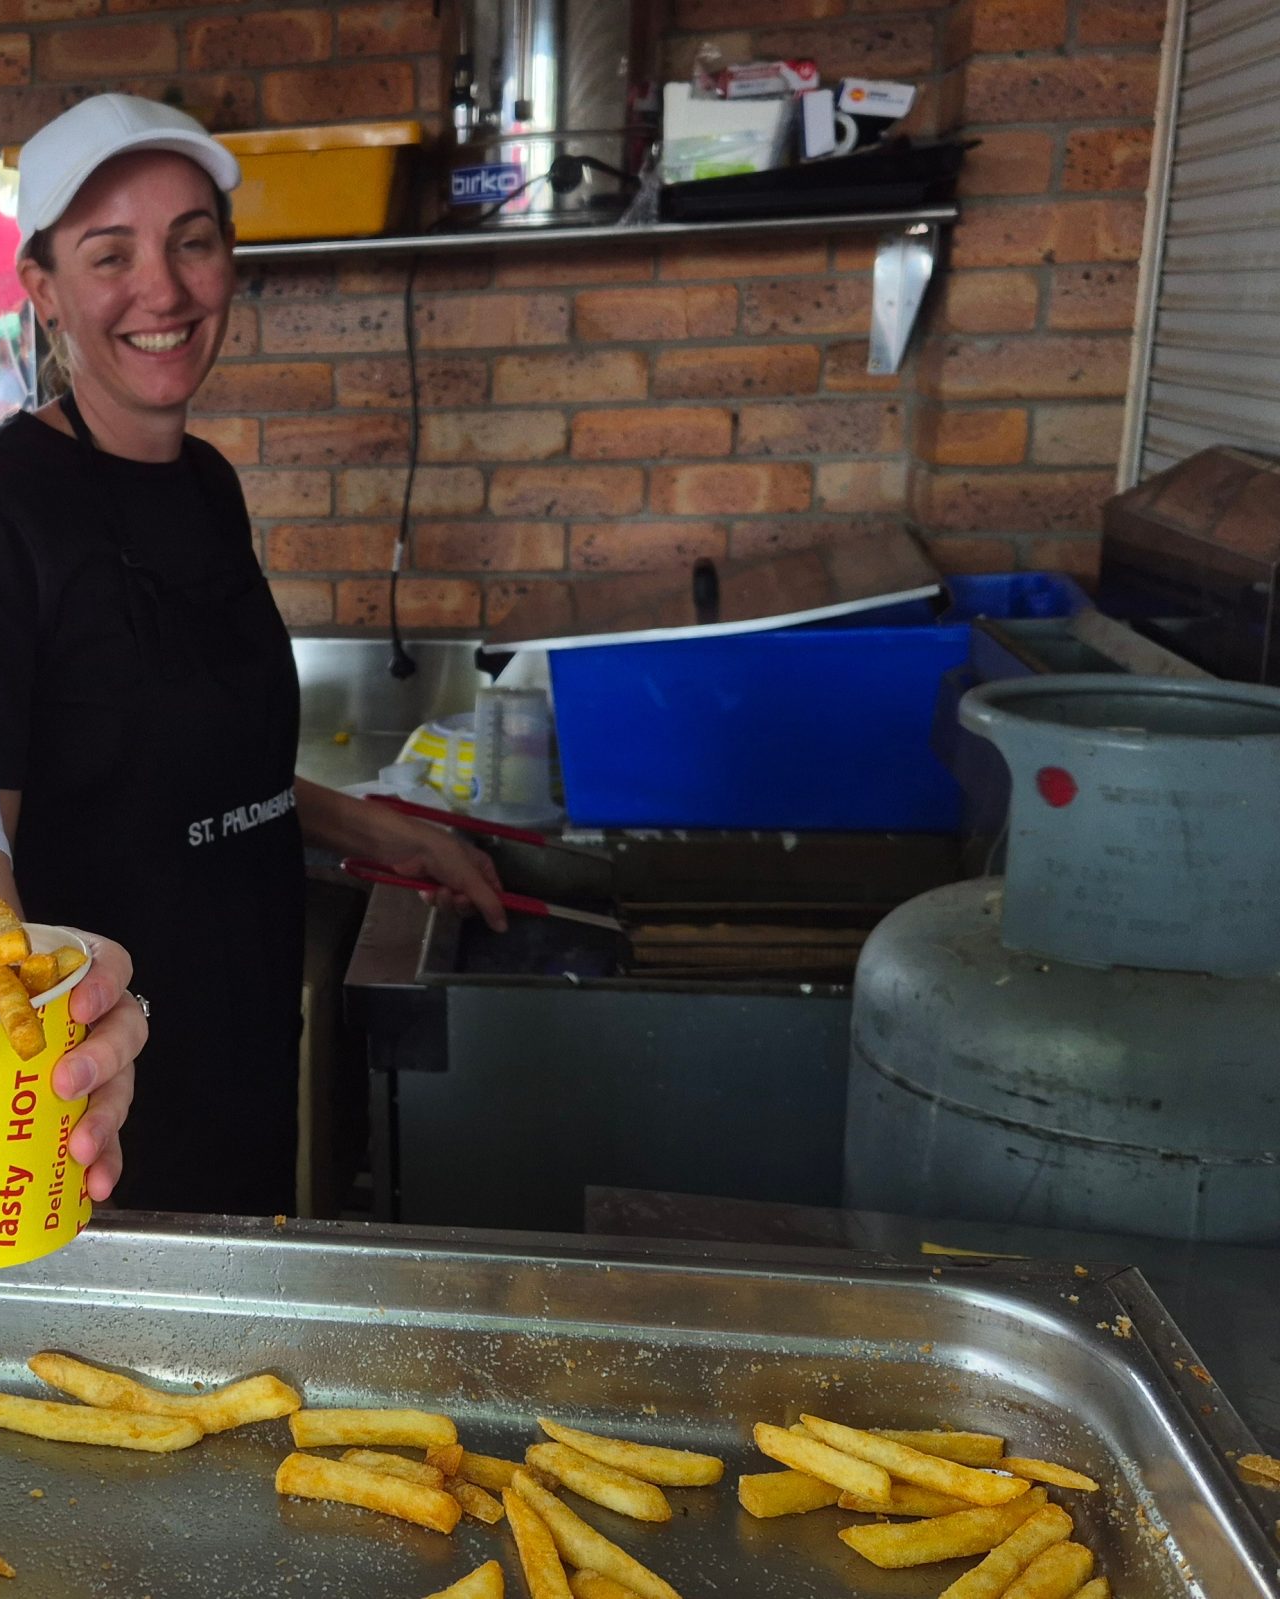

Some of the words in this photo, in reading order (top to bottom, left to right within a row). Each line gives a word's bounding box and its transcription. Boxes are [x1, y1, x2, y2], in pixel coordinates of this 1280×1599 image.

[452, 170, 518, 196] birko
[188, 817, 214, 846] ST.
[6, 1070, 40, 1142] HOT
[44, 1113, 71, 1231] Delicious
